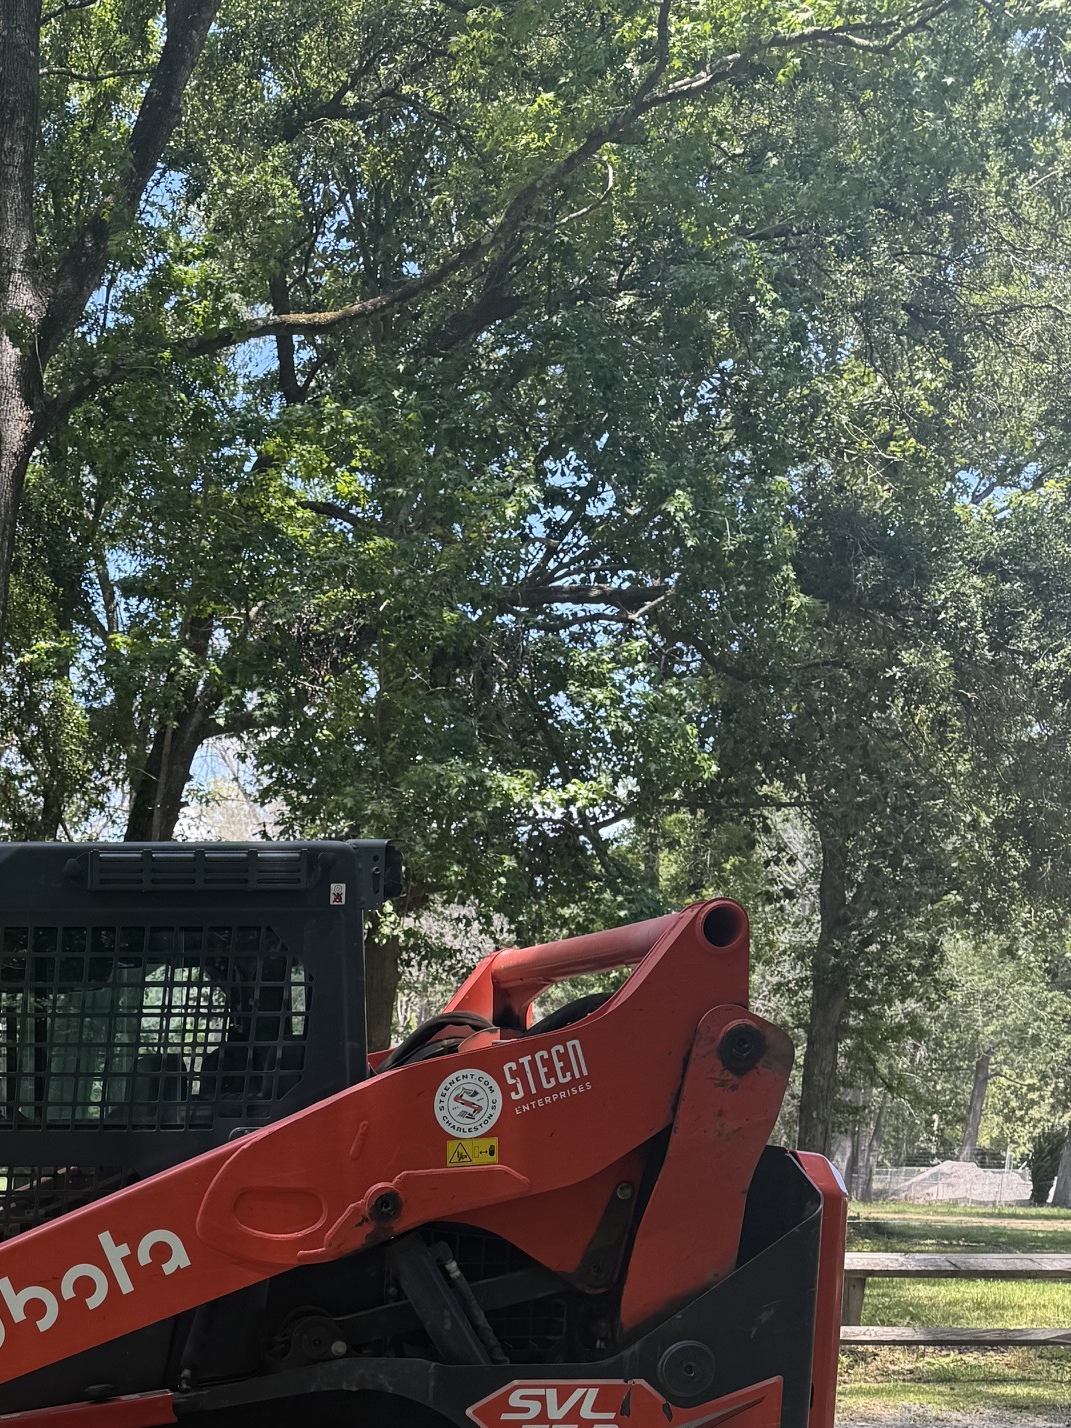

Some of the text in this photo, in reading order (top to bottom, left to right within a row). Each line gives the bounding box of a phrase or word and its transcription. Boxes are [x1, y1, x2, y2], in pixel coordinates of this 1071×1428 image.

[503, 1039, 589, 1100] STEEN
[438, 1073, 496, 1112] STEENENT.COM
[514, 1081, 593, 1115] ENTERPRISES
[501, 1388, 616, 1420] SVL
